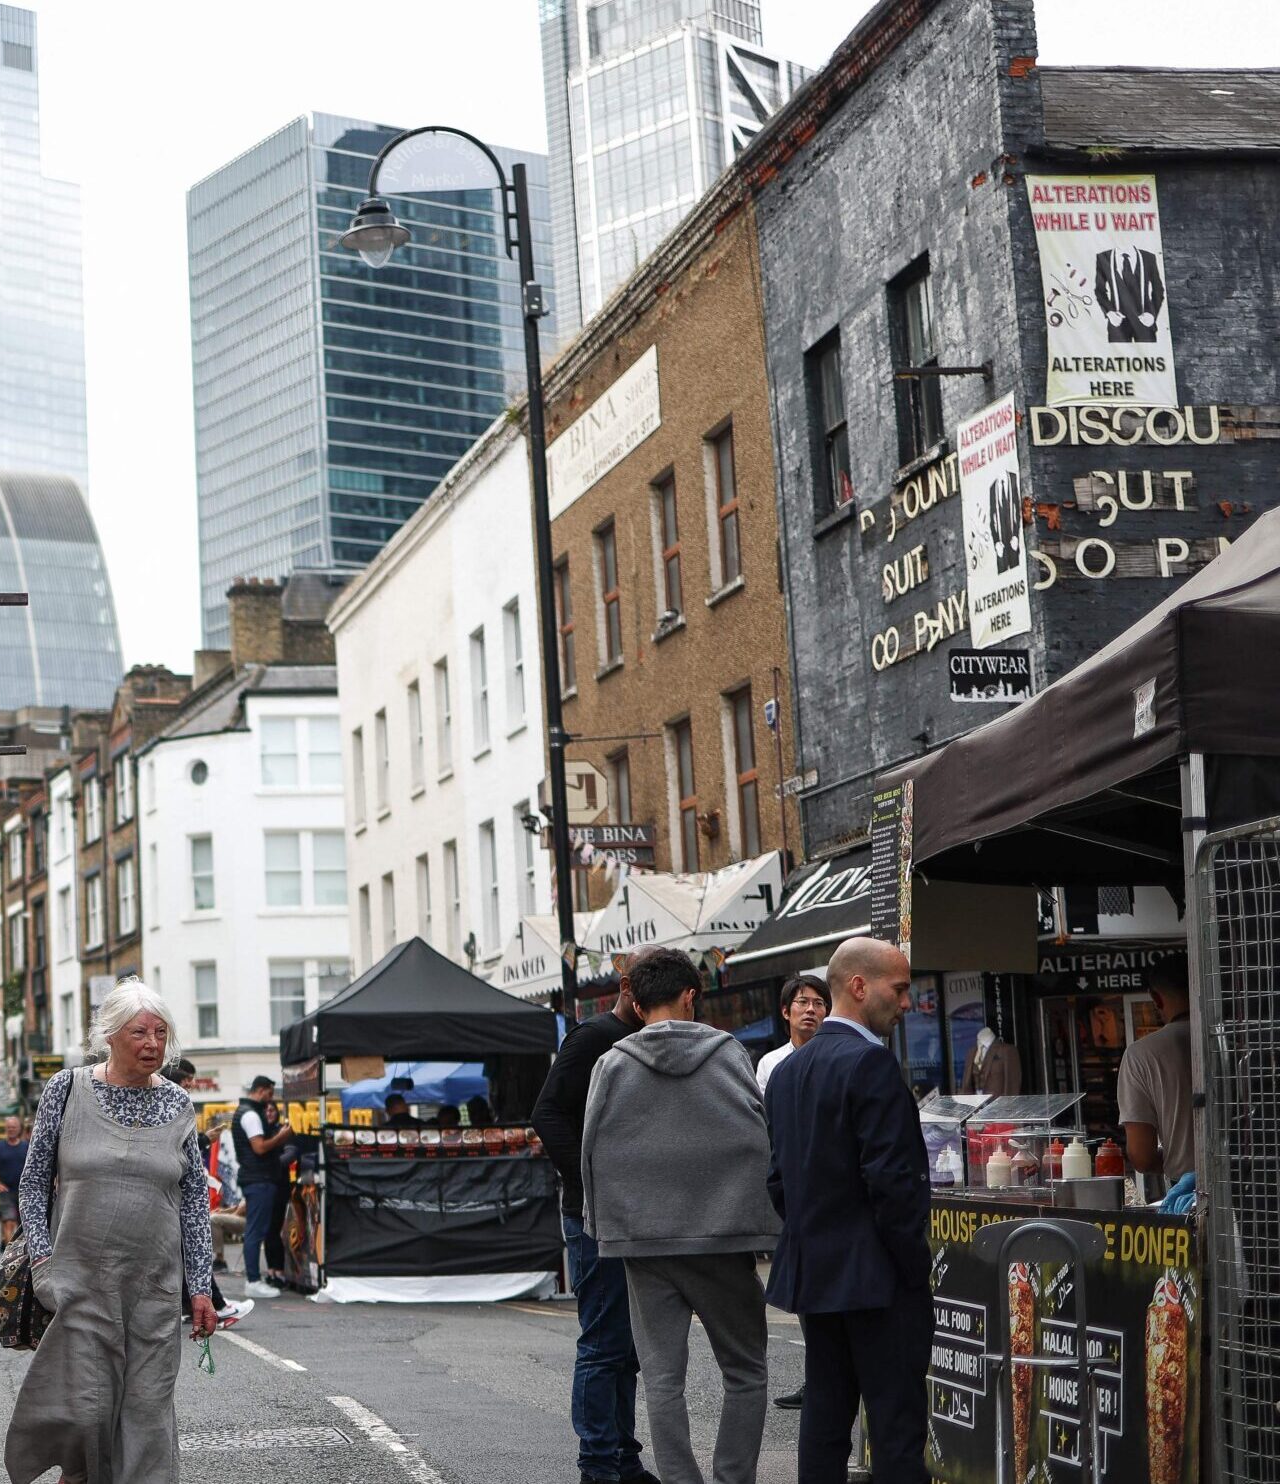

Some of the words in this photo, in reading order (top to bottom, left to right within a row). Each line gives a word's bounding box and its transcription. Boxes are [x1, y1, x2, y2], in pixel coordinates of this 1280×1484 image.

[1032, 184, 1151, 205] ALTERATIONS
[1034, 212, 1090, 232] WHILE
[1094, 213, 1108, 231] U
[1111, 212, 1157, 231] WAIT
[1051, 356, 1166, 373] ALTERATIONS
[1089, 380, 1135, 397] HERE
[960, 403, 1014, 450] ALTERATIONS
[960, 446, 987, 477] WHILE
[987, 447, 995, 463] U
[995, 431, 1017, 461] WAIT
[974, 578, 1026, 615] ALTERATIONS
[990, 610, 1012, 633] HERE
[950, 655, 1029, 676] CITYWEAR
[602, 826, 647, 843] BINA
[1097, 973, 1142, 989] HERE
[930, 1208, 977, 1243] HOUSE
[1122, 1225, 1190, 1268] DONER
[951, 1311, 971, 1332] FOOD
[1042, 1331, 1074, 1356] HALAL
[931, 1345, 953, 1371] HOUSE
[954, 1351, 978, 1378] DONER
[1048, 1376, 1079, 1406] HOUSE
